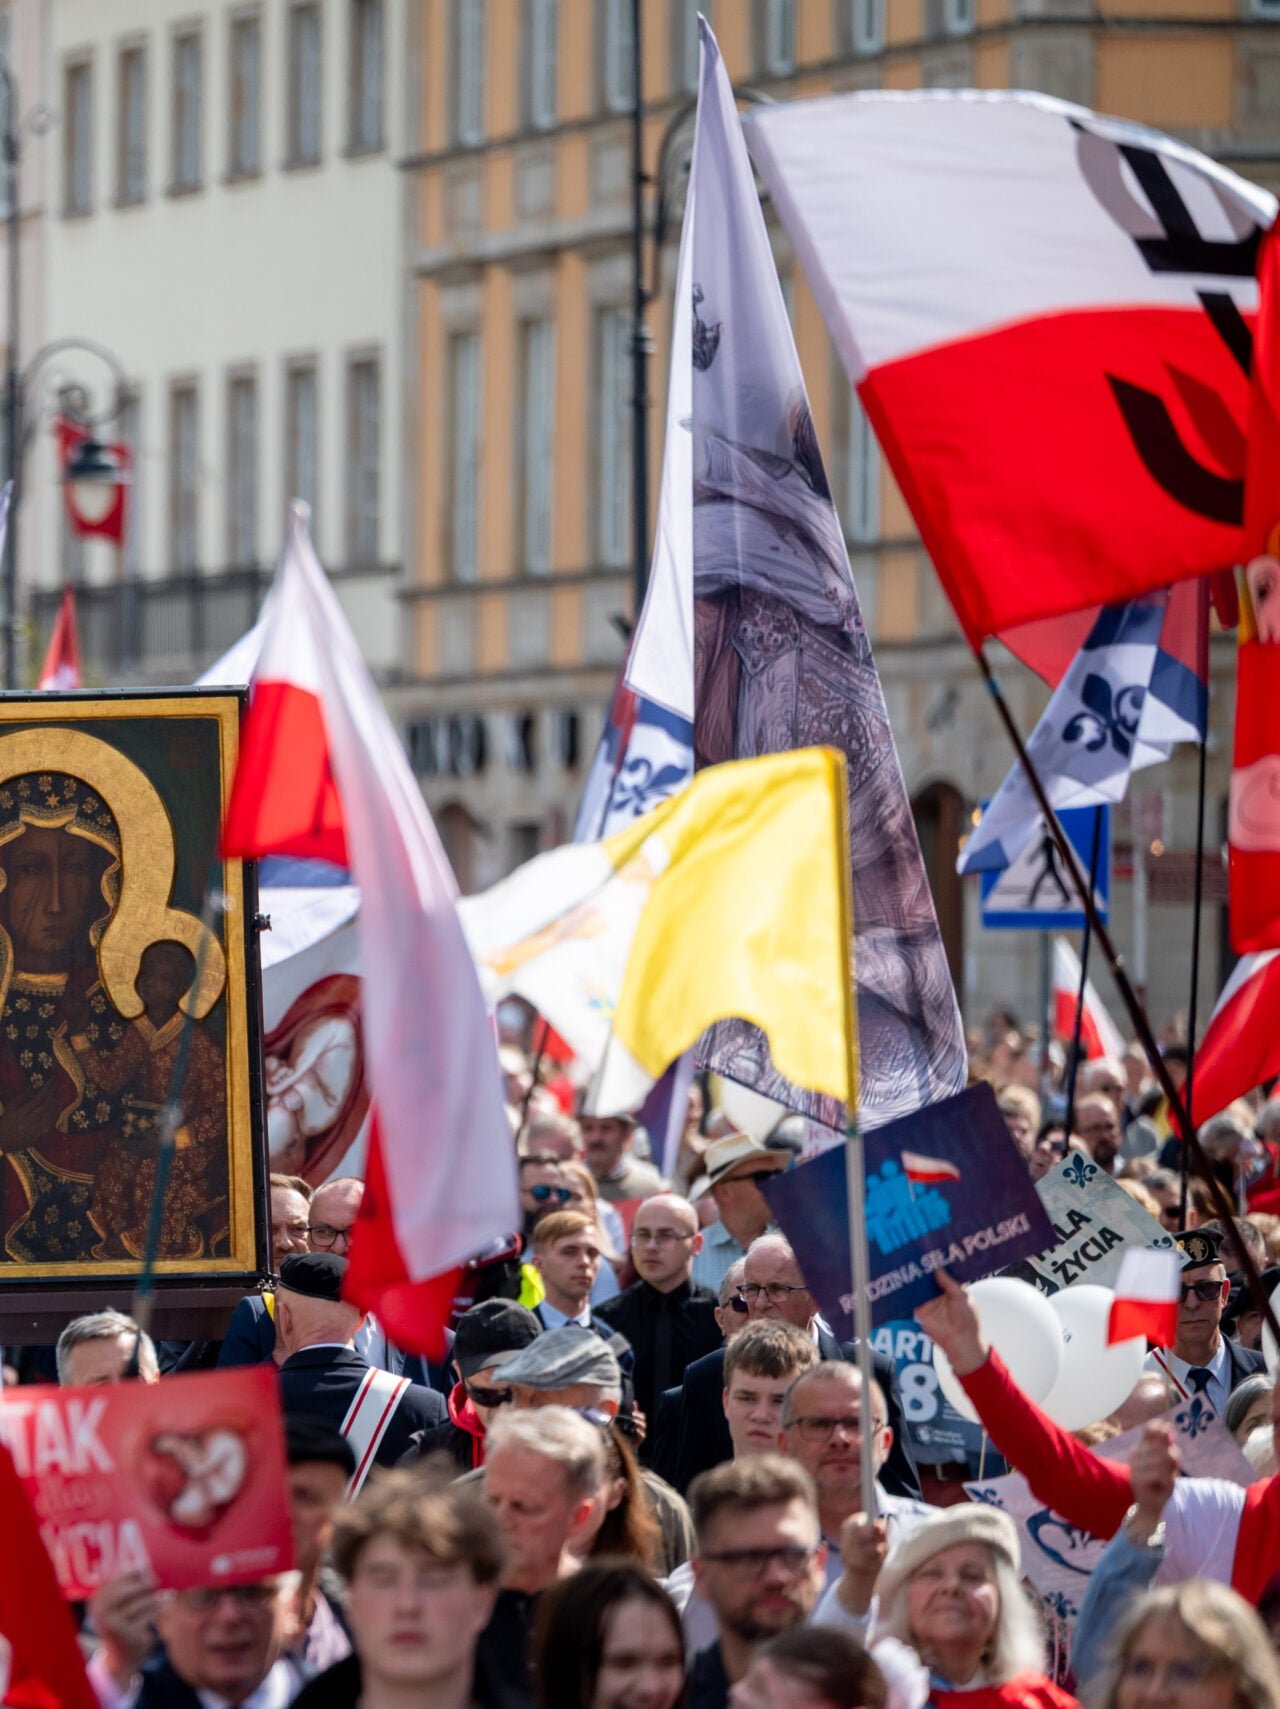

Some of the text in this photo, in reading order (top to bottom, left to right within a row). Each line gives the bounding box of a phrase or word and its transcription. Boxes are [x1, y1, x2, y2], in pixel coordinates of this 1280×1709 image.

[838, 1263, 922, 1316] RDZINA
[961, 1212, 1031, 1256] POLSKI
[1036, 1208, 1093, 1263] LA
[1051, 1226, 1125, 1286] ŻYCIA
[899, 1362, 939, 1423] 8
[0, 1396, 116, 1480] TAK
[40, 1518, 160, 1588] YCIA
